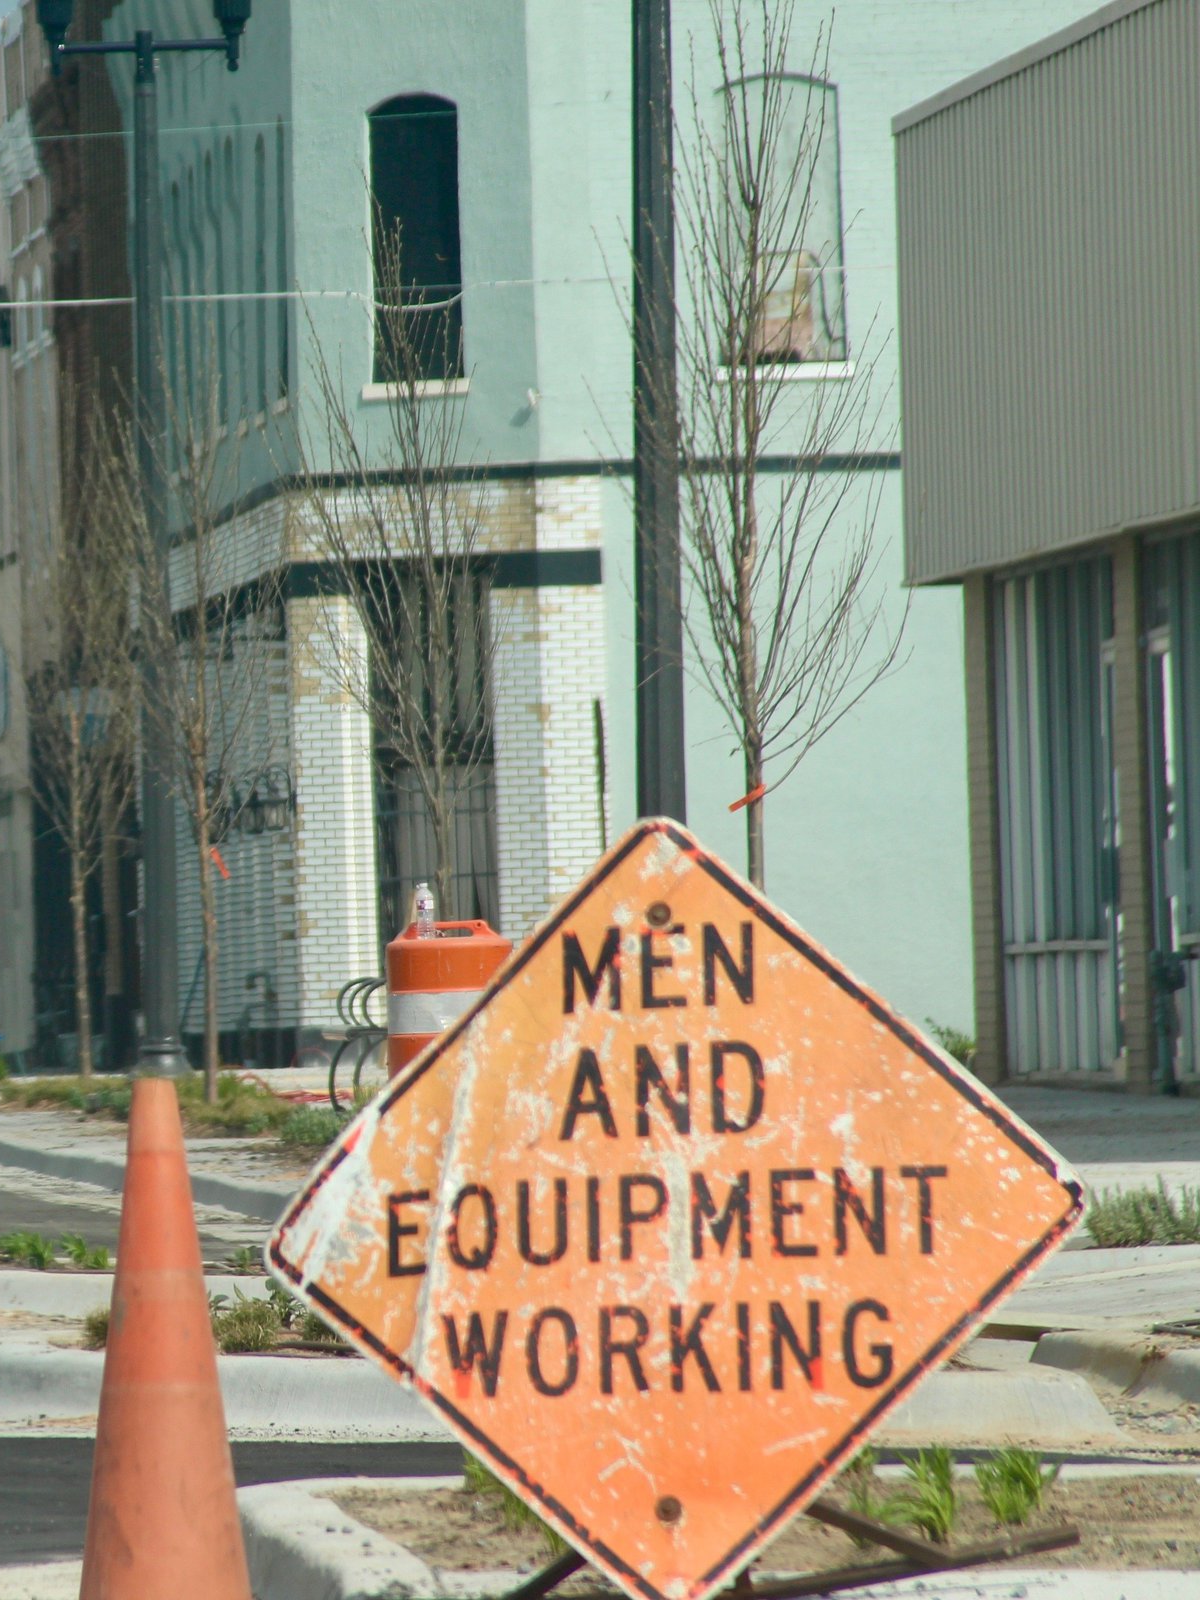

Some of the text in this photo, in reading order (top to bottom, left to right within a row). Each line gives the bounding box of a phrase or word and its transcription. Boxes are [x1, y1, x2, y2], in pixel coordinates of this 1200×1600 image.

[562, 922, 755, 1013] MEN
[559, 1040, 766, 1141] AND
[388, 1165, 948, 1277] EQUIPMENT
[442, 1299, 894, 1398] WORKING
